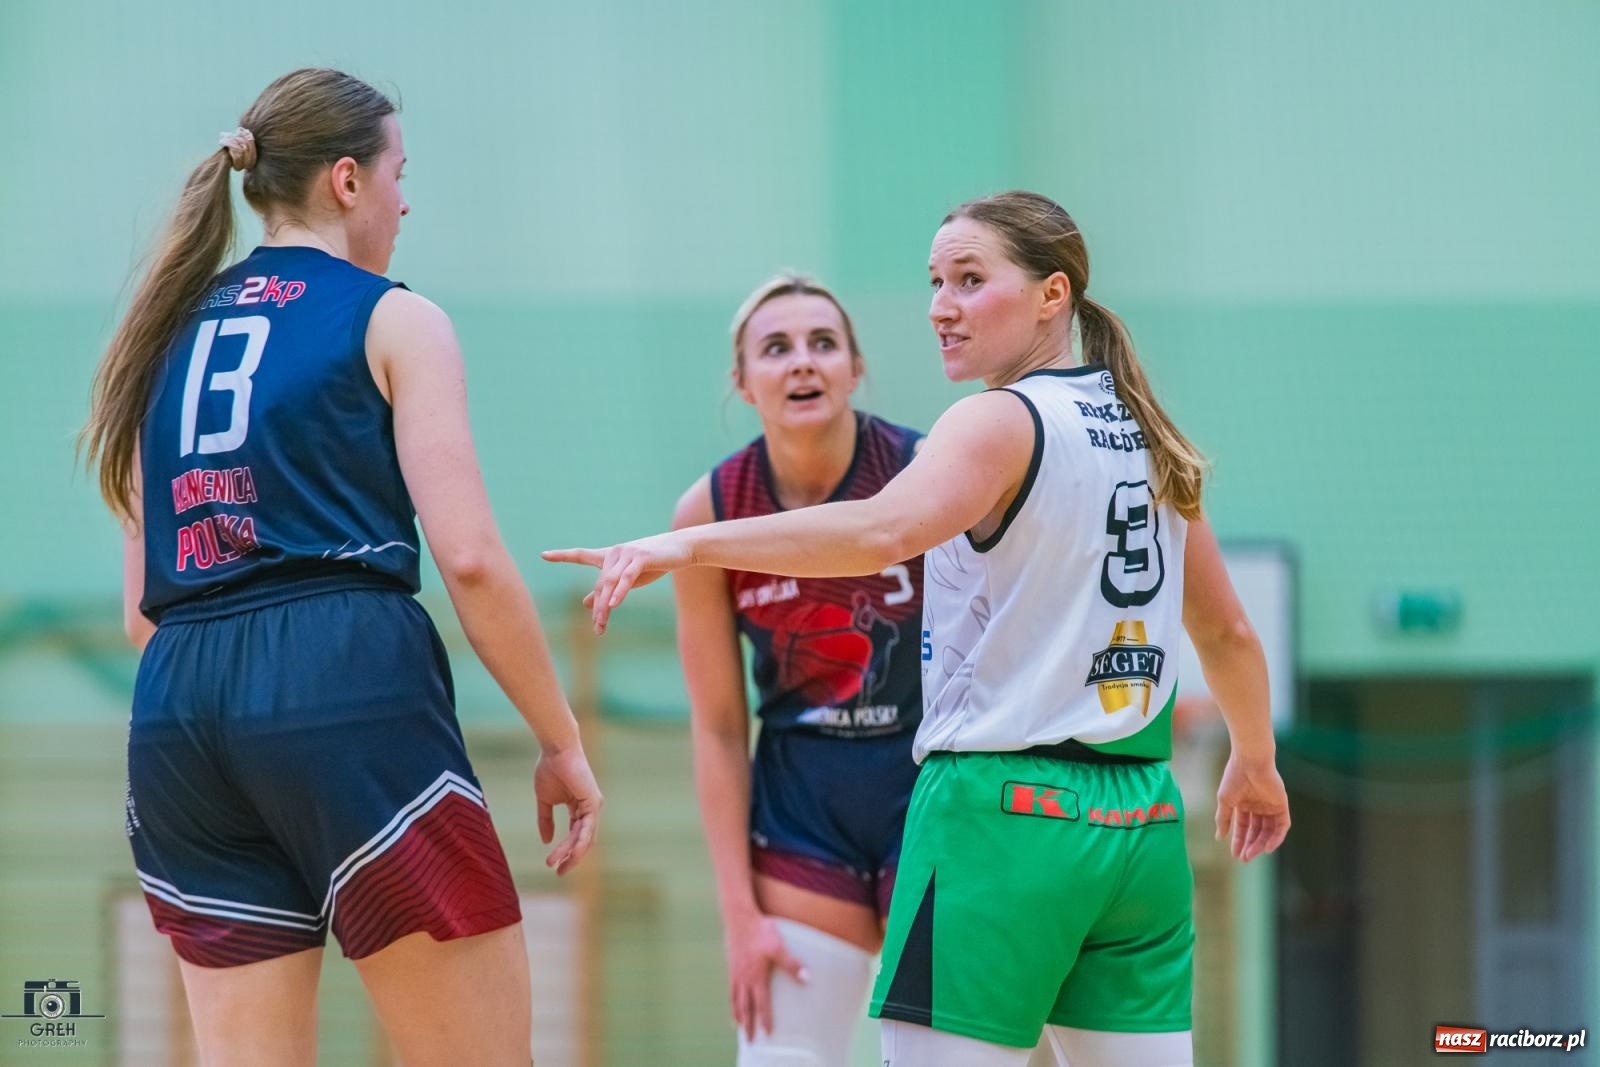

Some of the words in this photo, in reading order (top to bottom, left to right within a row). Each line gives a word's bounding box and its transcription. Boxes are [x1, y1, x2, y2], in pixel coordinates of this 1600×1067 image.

[180, 315, 270, 459] 13
[1091, 651, 1162, 676] SEGET
[1011, 785, 1068, 818] K
